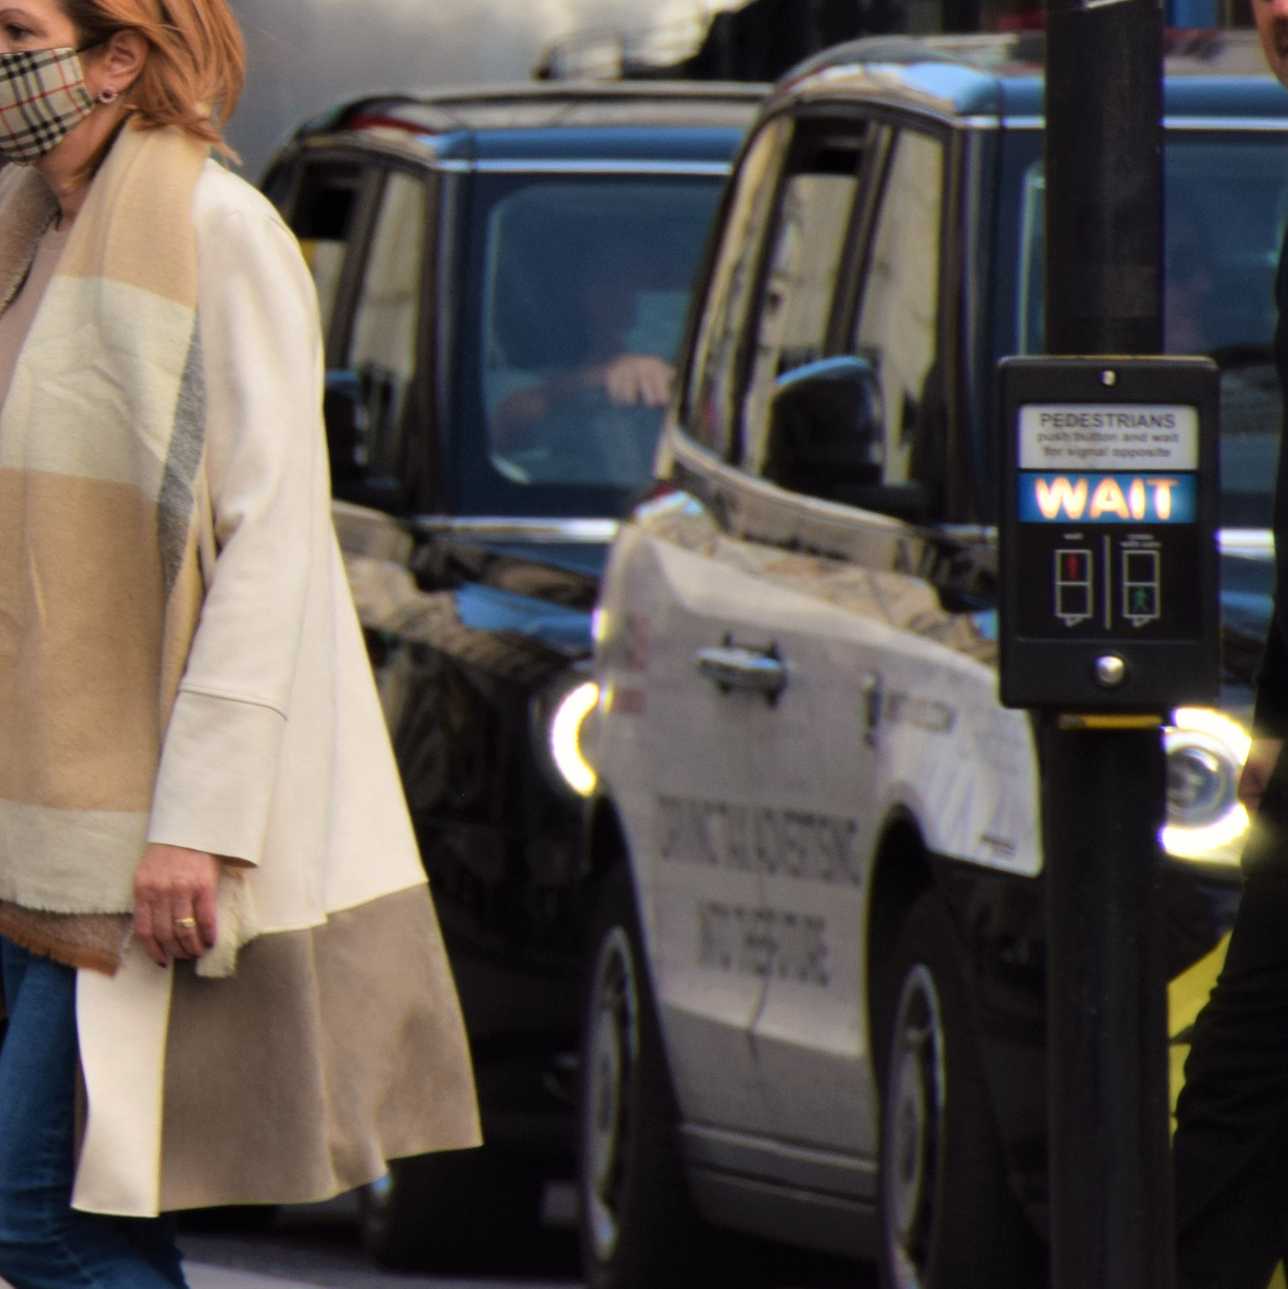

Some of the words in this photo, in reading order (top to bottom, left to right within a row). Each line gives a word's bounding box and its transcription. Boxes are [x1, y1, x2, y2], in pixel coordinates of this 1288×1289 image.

[1039, 412, 1176, 428] PEDESTRIANS
[1122, 432, 1148, 442] and
[1035, 476, 1179, 520] WAIT
